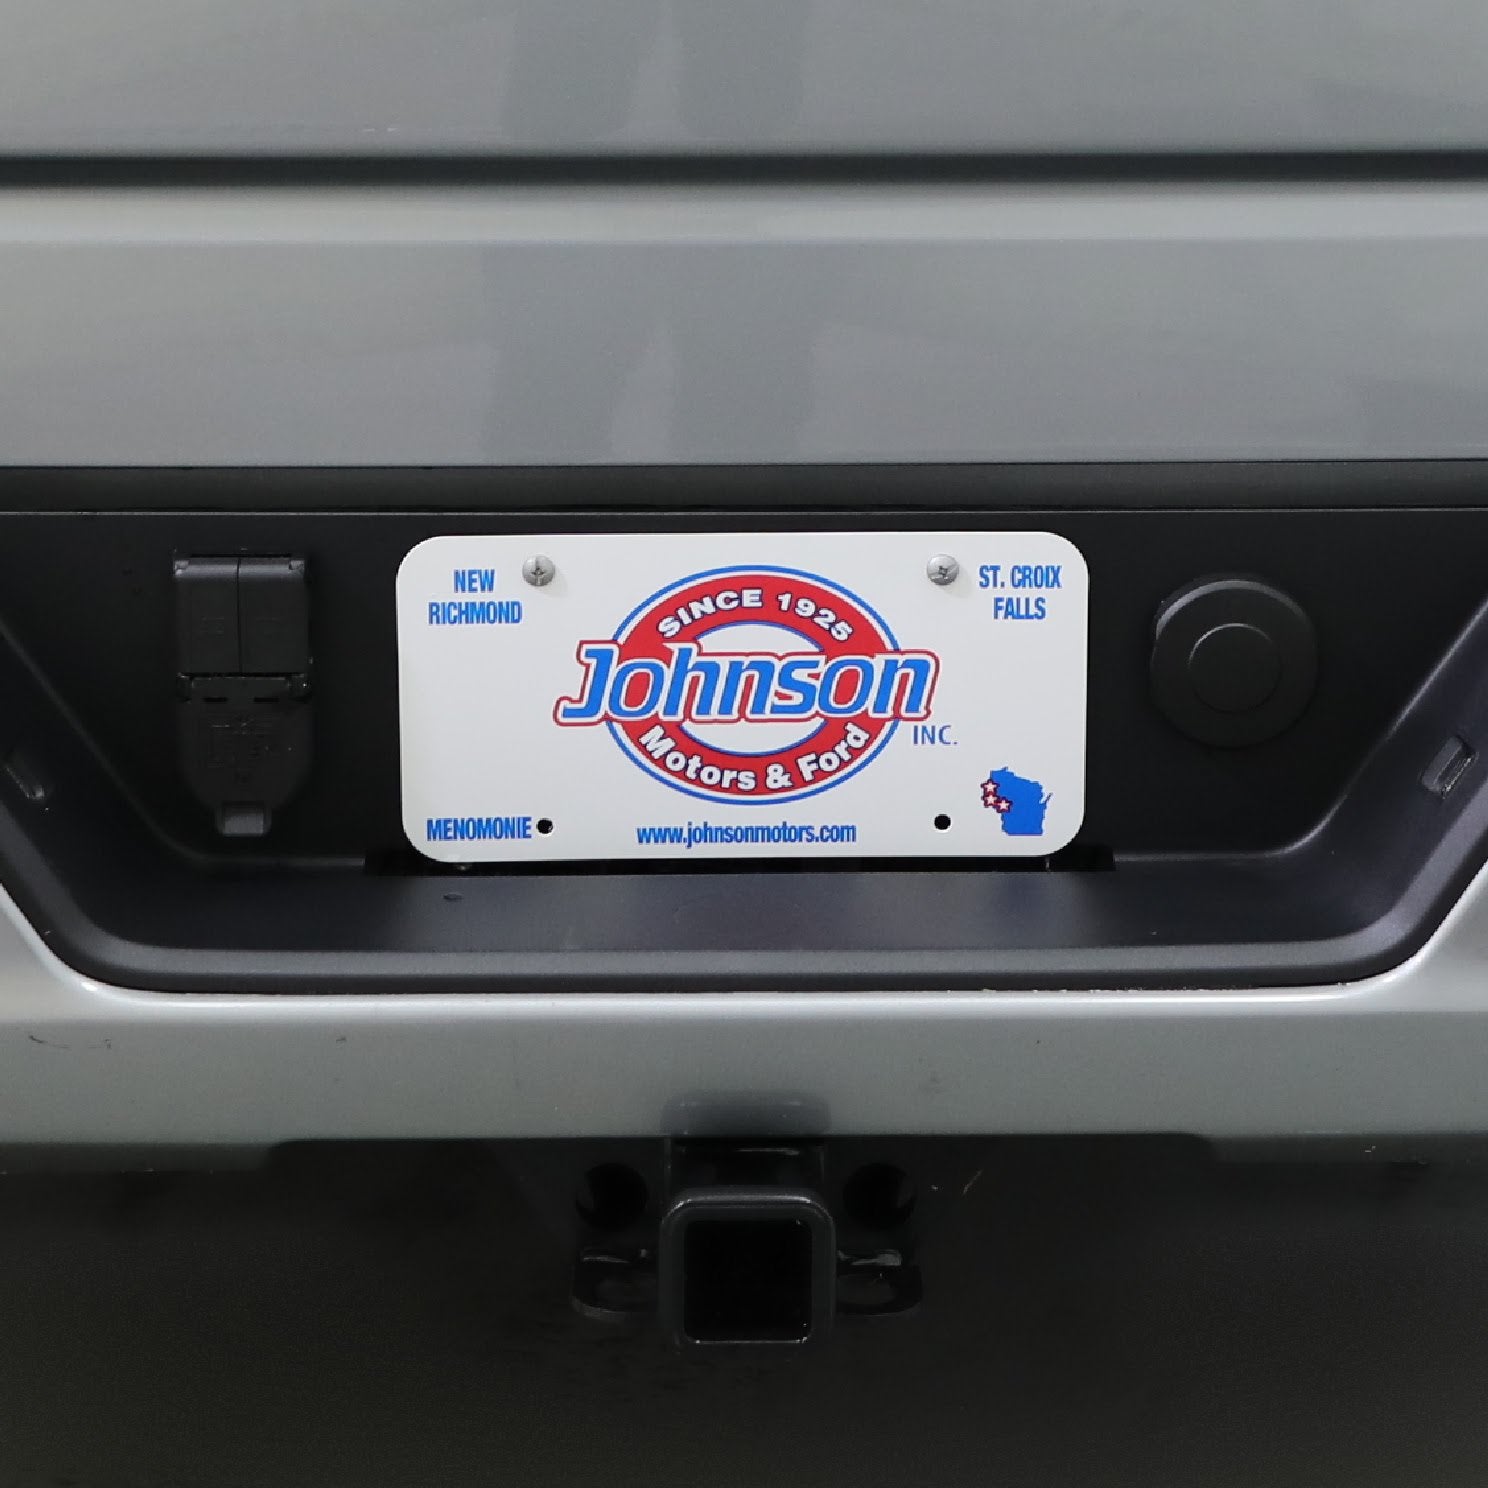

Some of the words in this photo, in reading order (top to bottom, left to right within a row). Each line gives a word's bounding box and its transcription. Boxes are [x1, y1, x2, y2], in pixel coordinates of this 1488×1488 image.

[454, 568, 495, 593] NEW
[978, 564, 1005, 588] ST.
[1010, 564, 1063, 589] CROIX
[428, 600, 523, 625] RICHMOND
[657, 588, 763, 639] SINCE
[777, 591, 854, 642] 1925
[993, 596, 1047, 620] FALLS
[557, 643, 936, 722] Johnson
[912, 725, 959, 746] INC.
[638, 724, 756, 791] Motors
[765, 763, 793, 790] &
[796, 722, 871, 784] Ford
[426, 816, 532, 842] MENOMONIE
[636, 821, 857, 849] www.johnsonmotors.com
